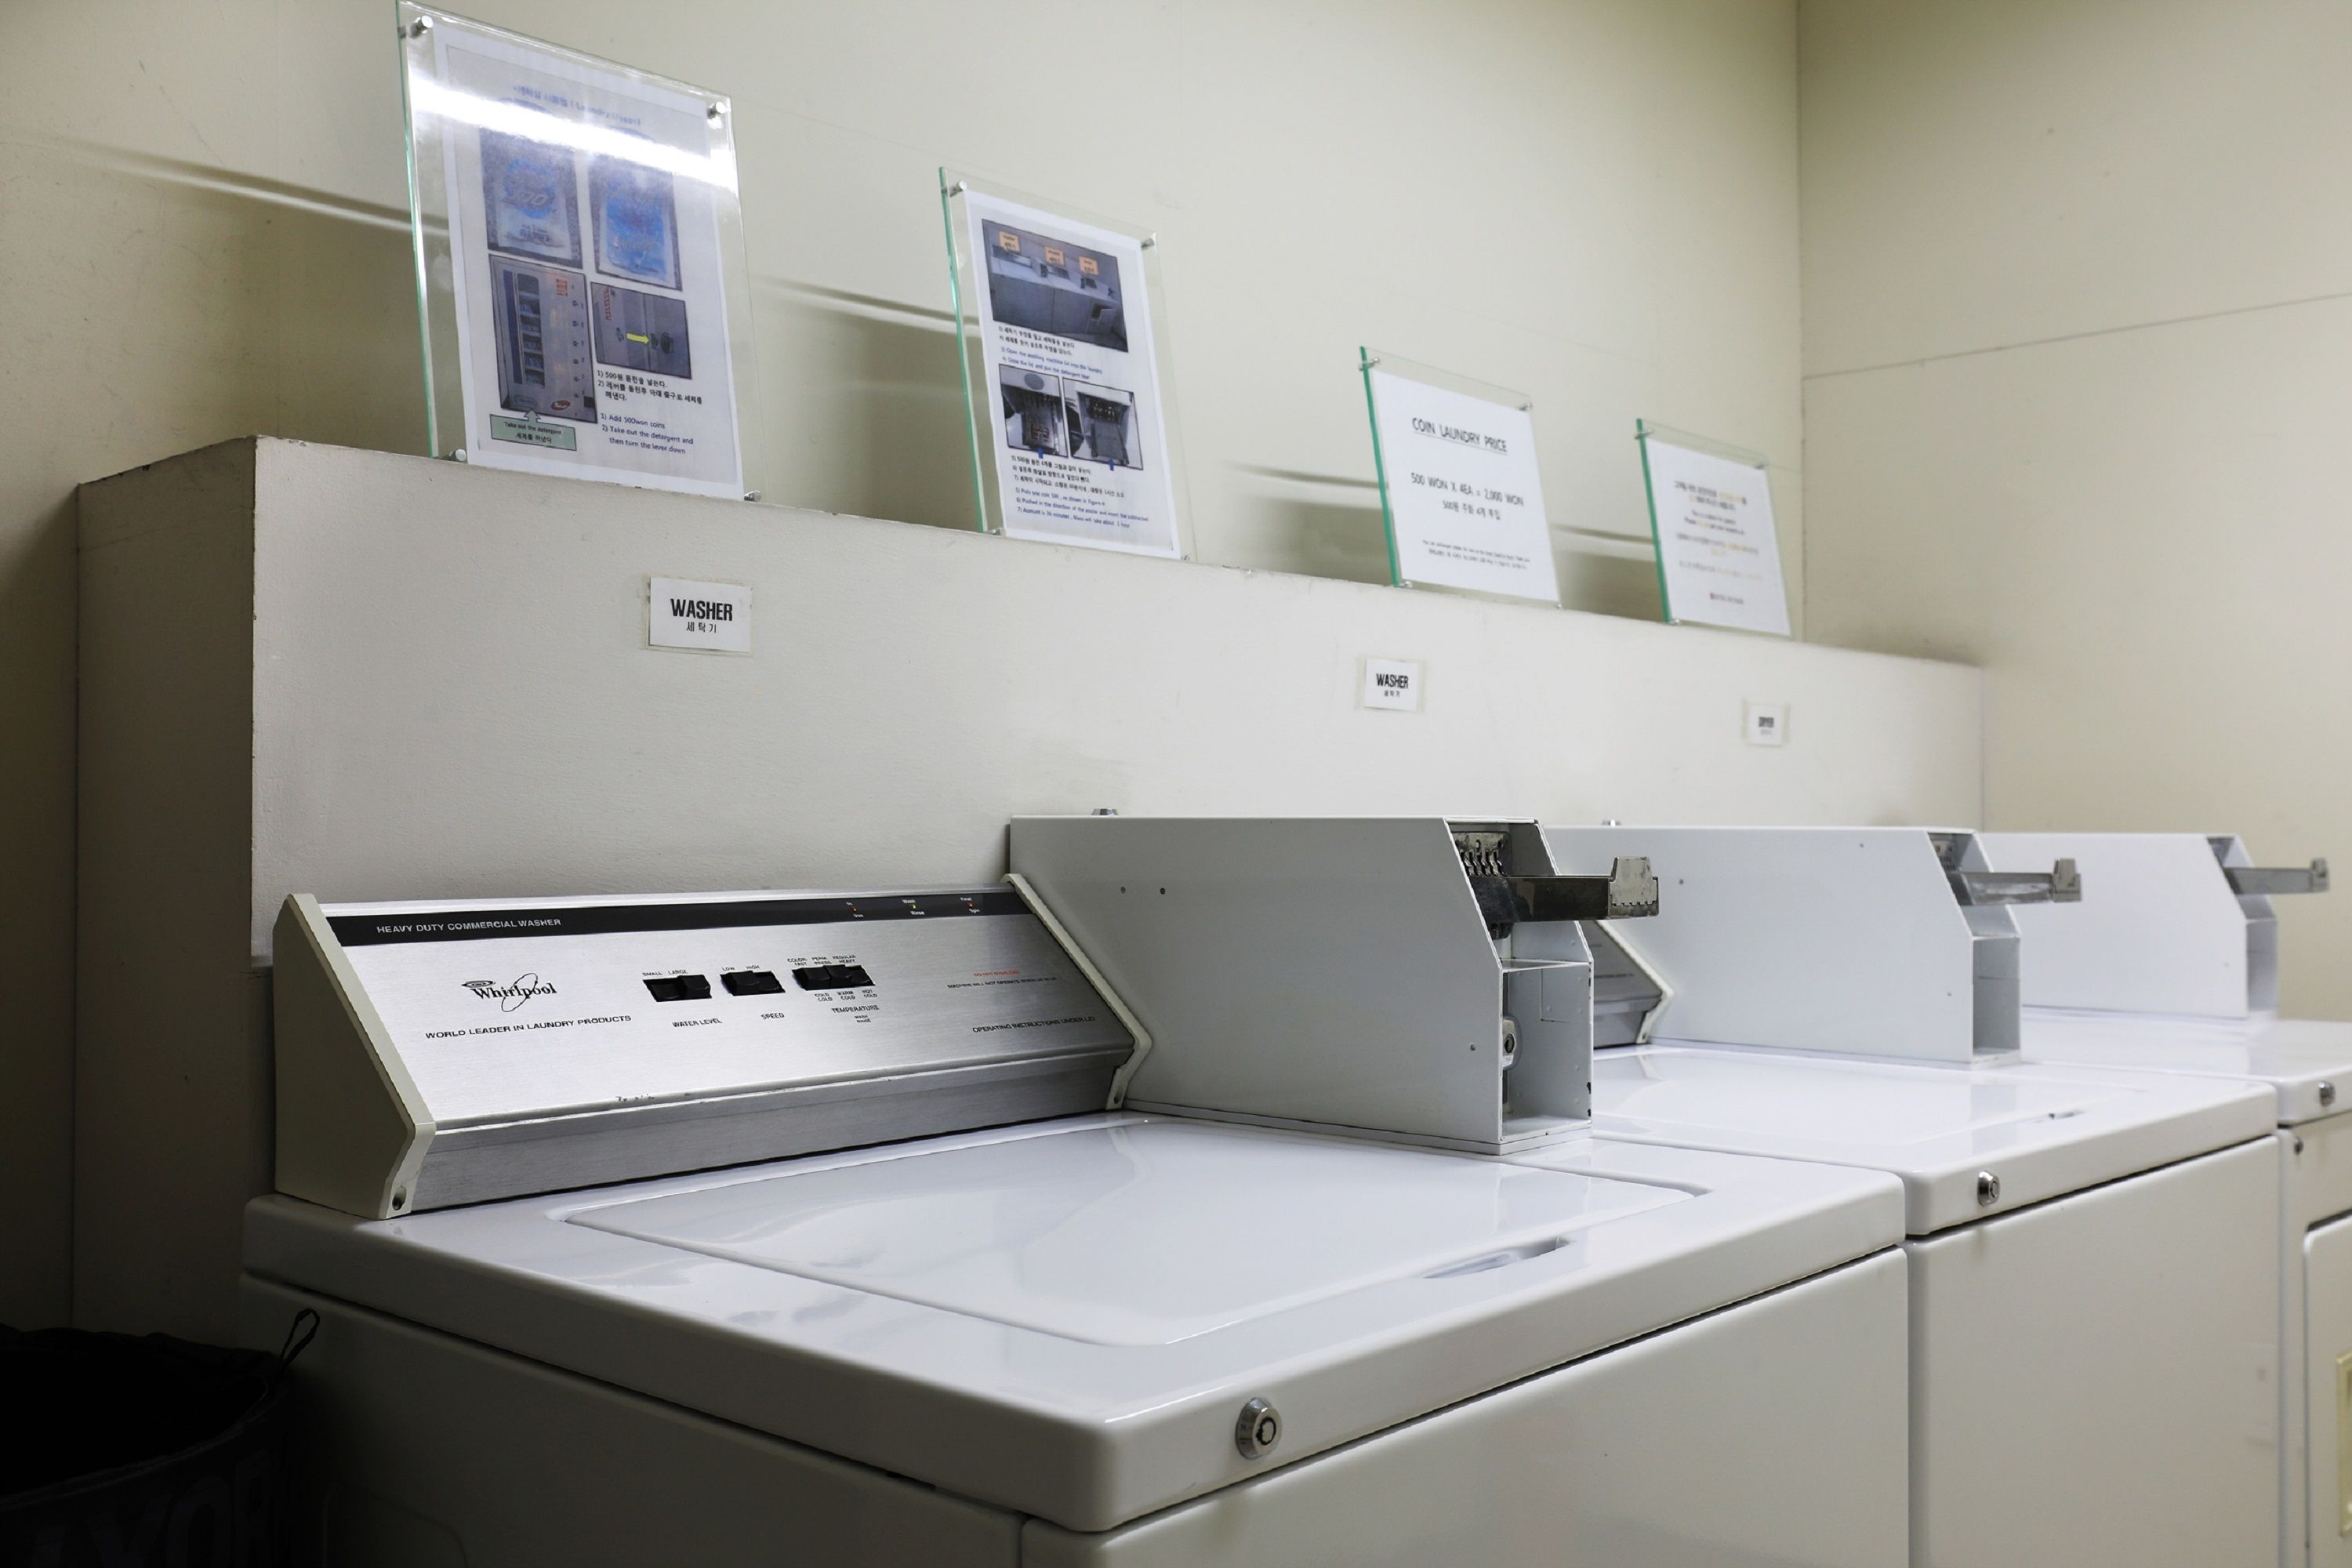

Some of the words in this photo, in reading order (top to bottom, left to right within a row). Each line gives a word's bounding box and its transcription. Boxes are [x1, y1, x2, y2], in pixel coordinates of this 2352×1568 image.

[624, 416, 648, 426] 500won
[537, 426, 562, 435] detergent
[601, 424, 608, 433] 2)
[610, 426, 625, 434] Take
[651, 432, 681, 443] detergent
[1412, 417, 1436, 434] COIN
[1439, 424, 1480, 445] LAUNDRY
[1484, 436, 1507, 452] PRICE
[609, 437, 624, 445] then
[641, 441, 651, 449] the
[669, 445, 686, 455] down
[1411, 472, 1425, 485] 500
[1428, 476, 1448, 489] WON
[1505, 493, 1524, 506] WON
[670, 598, 732, 622] WASHER
[1376, 673, 1409, 689] WASHER
[376, 924, 413, 934] HEAVY
[416, 923, 445, 932] DUTY
[448, 920, 517, 931] COMMERCIAL
[518, 919, 561, 927] WASHER
[470, 982, 557, 999] Whirlpool
[426, 1029, 466, 1039] WORLD
[469, 1025, 511, 1035] LEADER
[527, 1020, 575, 1029] LAUNDRY
[577, 1015, 632, 1025] PRODUCTS
[972, 1023, 1012, 1033] OPERATING
[1012, 1019, 1060, 1029] INSTRUCTIONS
